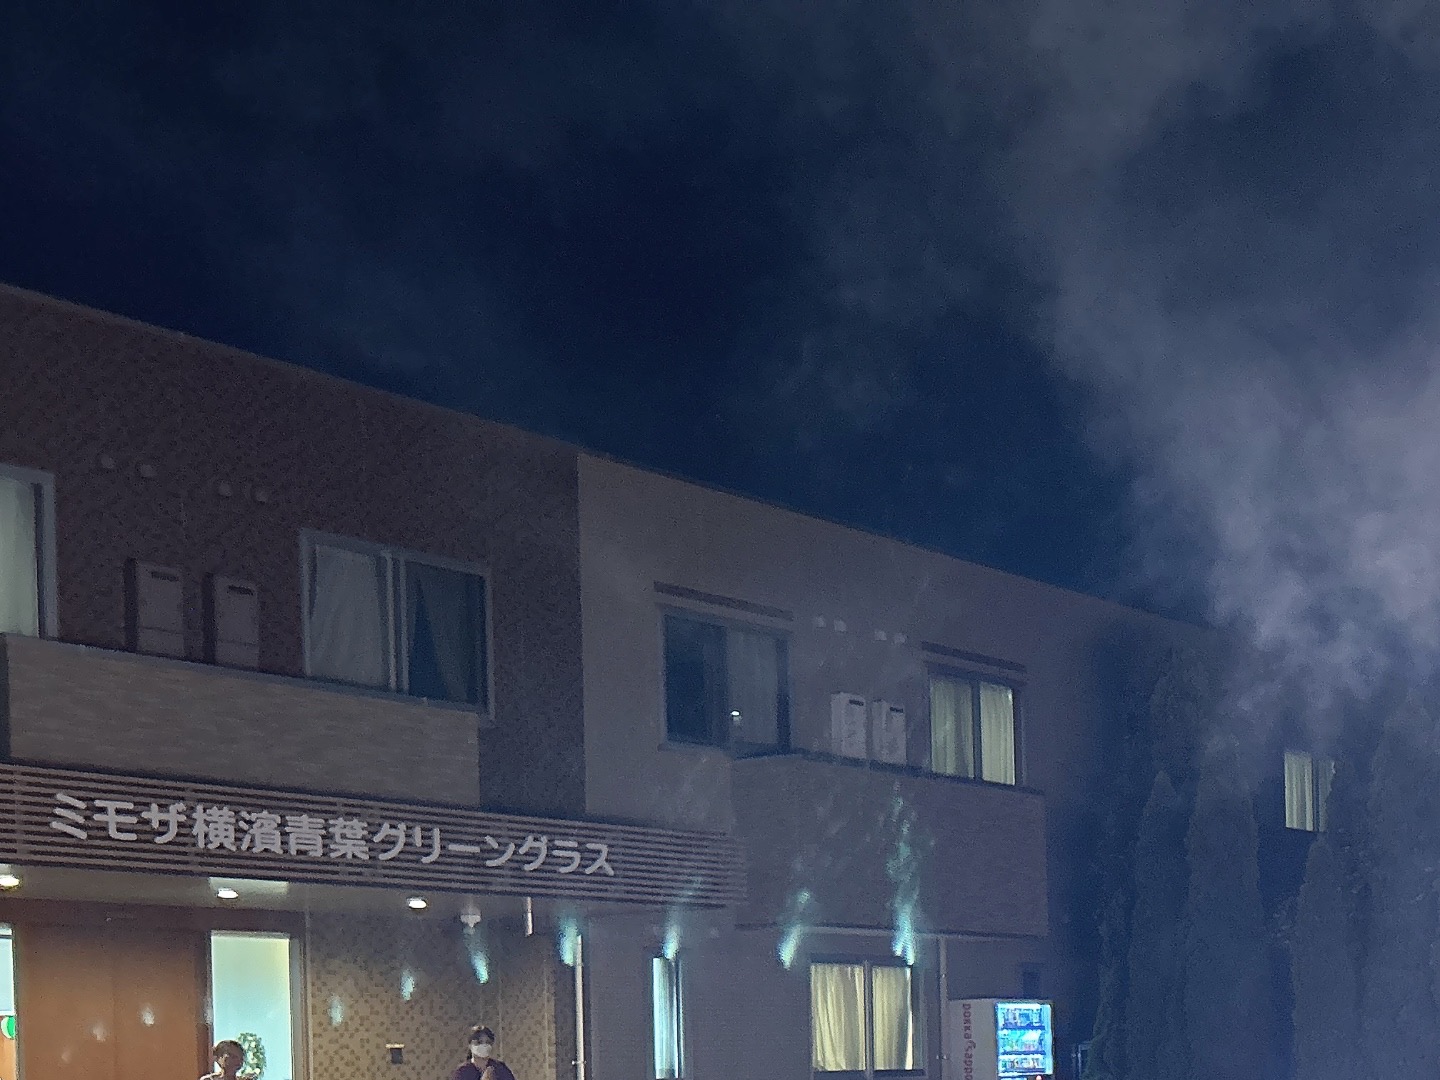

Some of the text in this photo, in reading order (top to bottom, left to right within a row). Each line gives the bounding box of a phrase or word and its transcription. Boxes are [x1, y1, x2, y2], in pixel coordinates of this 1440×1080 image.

[50, 793, 615, 877] ミモザ横濱青葉グリーングラス
